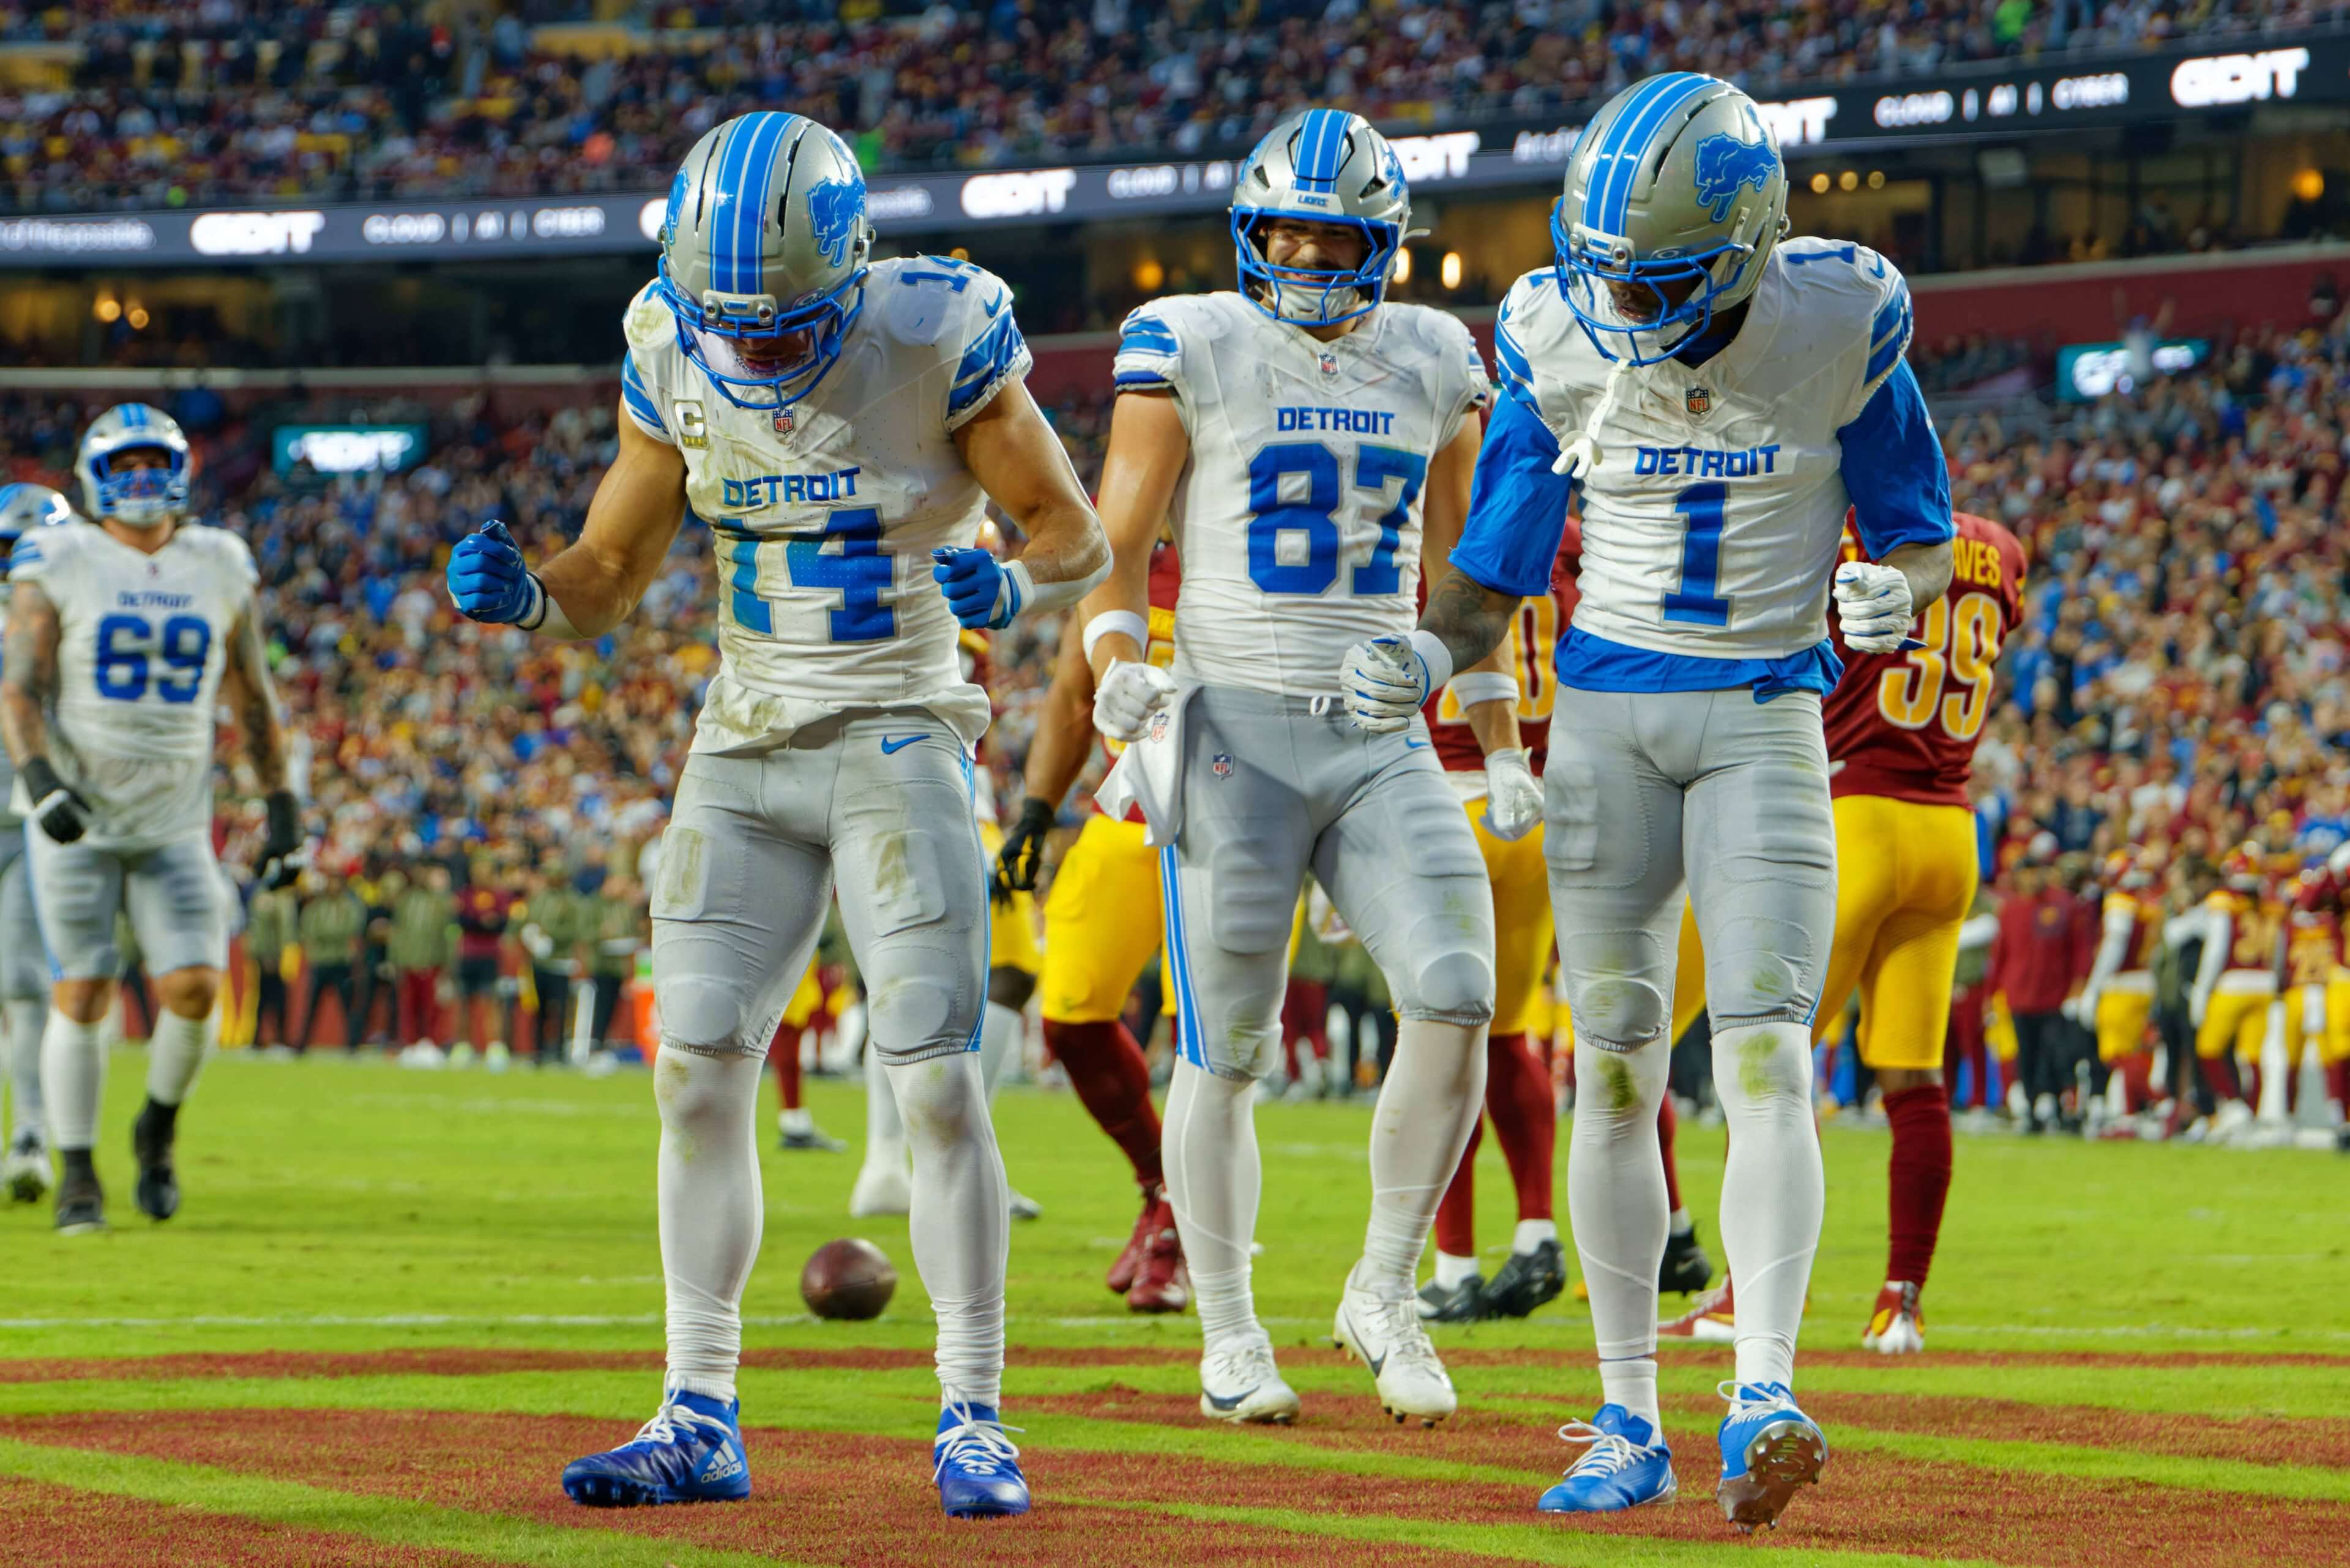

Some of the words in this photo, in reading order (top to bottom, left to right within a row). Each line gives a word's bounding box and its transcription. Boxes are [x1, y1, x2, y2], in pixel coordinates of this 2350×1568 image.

[675, 401, 704, 436] C
[1277, 406, 1395, 435] DETROIT
[722, 466, 860, 507] DETROIT
[1635, 444, 1780, 477] DETROIT
[1246, 439, 1427, 598] 87
[716, 503, 898, 644] 14
[1662, 482, 1734, 630] 1
[95, 615, 211, 703] 69
[1878, 592, 2002, 742] 39
[701, 1461, 742, 1484] adidas
